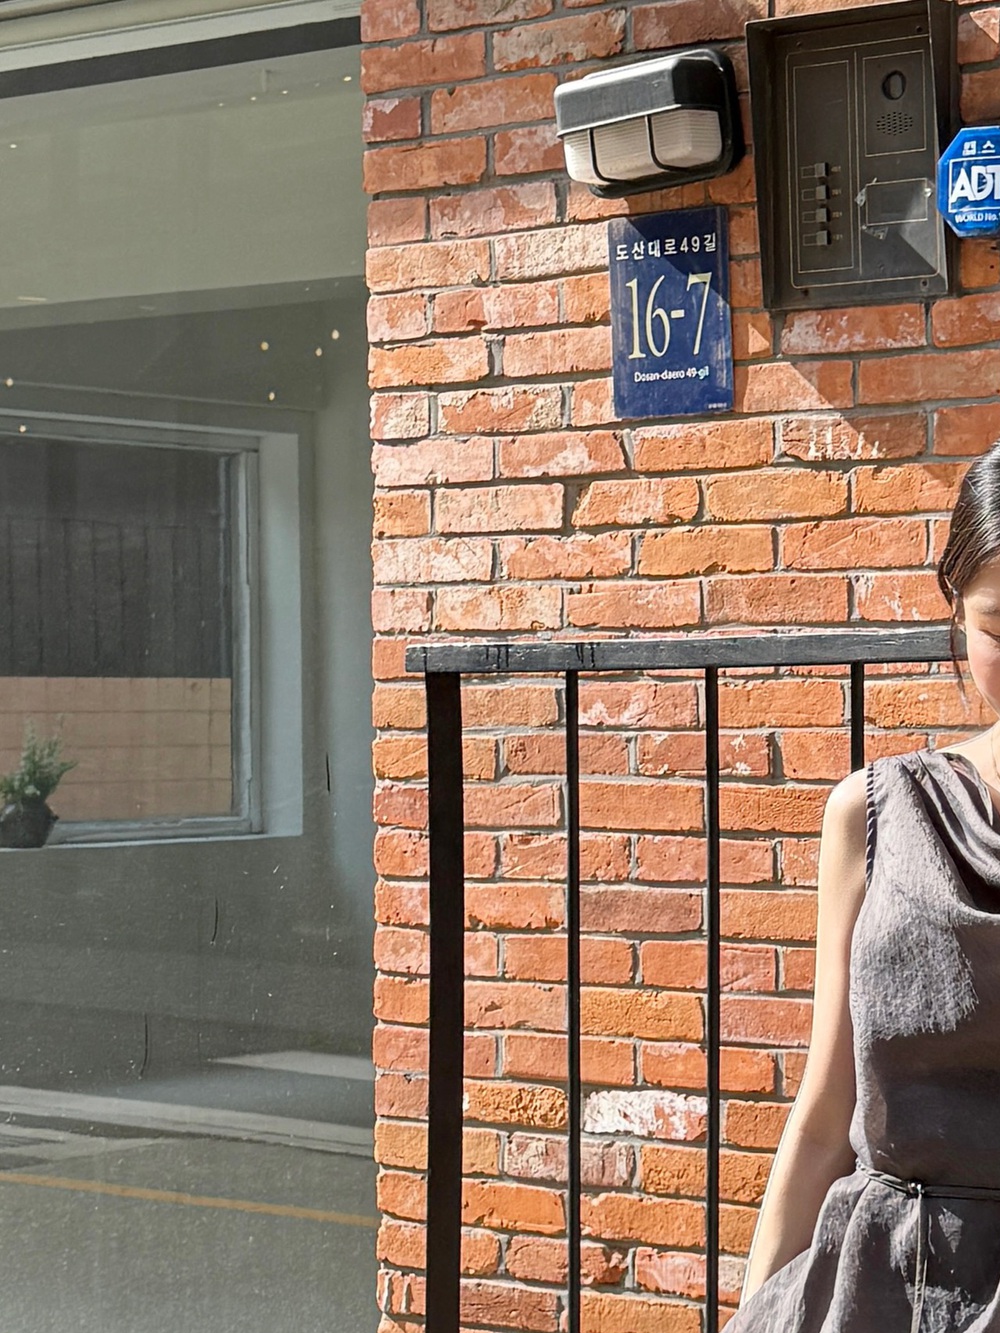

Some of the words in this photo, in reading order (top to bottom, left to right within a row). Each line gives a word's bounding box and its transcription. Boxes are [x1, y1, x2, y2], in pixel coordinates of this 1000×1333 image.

[954, 212, 984, 223] WORLD
[615, 232, 717, 260] 도산대로49길
[625, 271, 713, 359] 16-7
[634, 369, 685, 383] Dosan-daero
[686, 365, 710, 380] 49-gil
